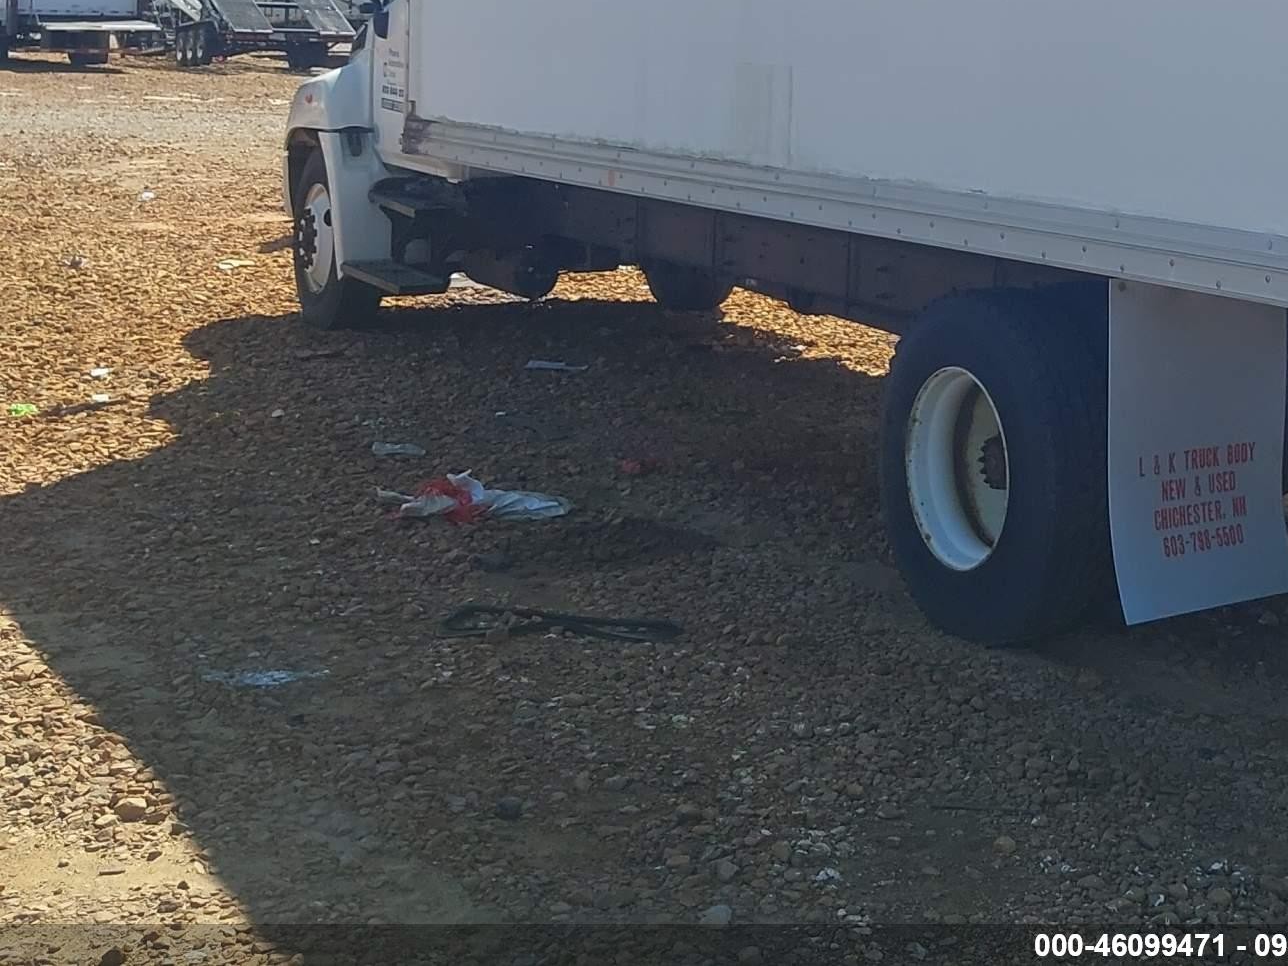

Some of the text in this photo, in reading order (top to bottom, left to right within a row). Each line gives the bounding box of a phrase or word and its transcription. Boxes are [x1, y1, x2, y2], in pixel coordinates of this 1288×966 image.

[1139, 442, 1256, 477] L & K TRUCK BODY
[1161, 471, 1236, 502] NEW & USED
[1232, 496, 1247, 517] NH
